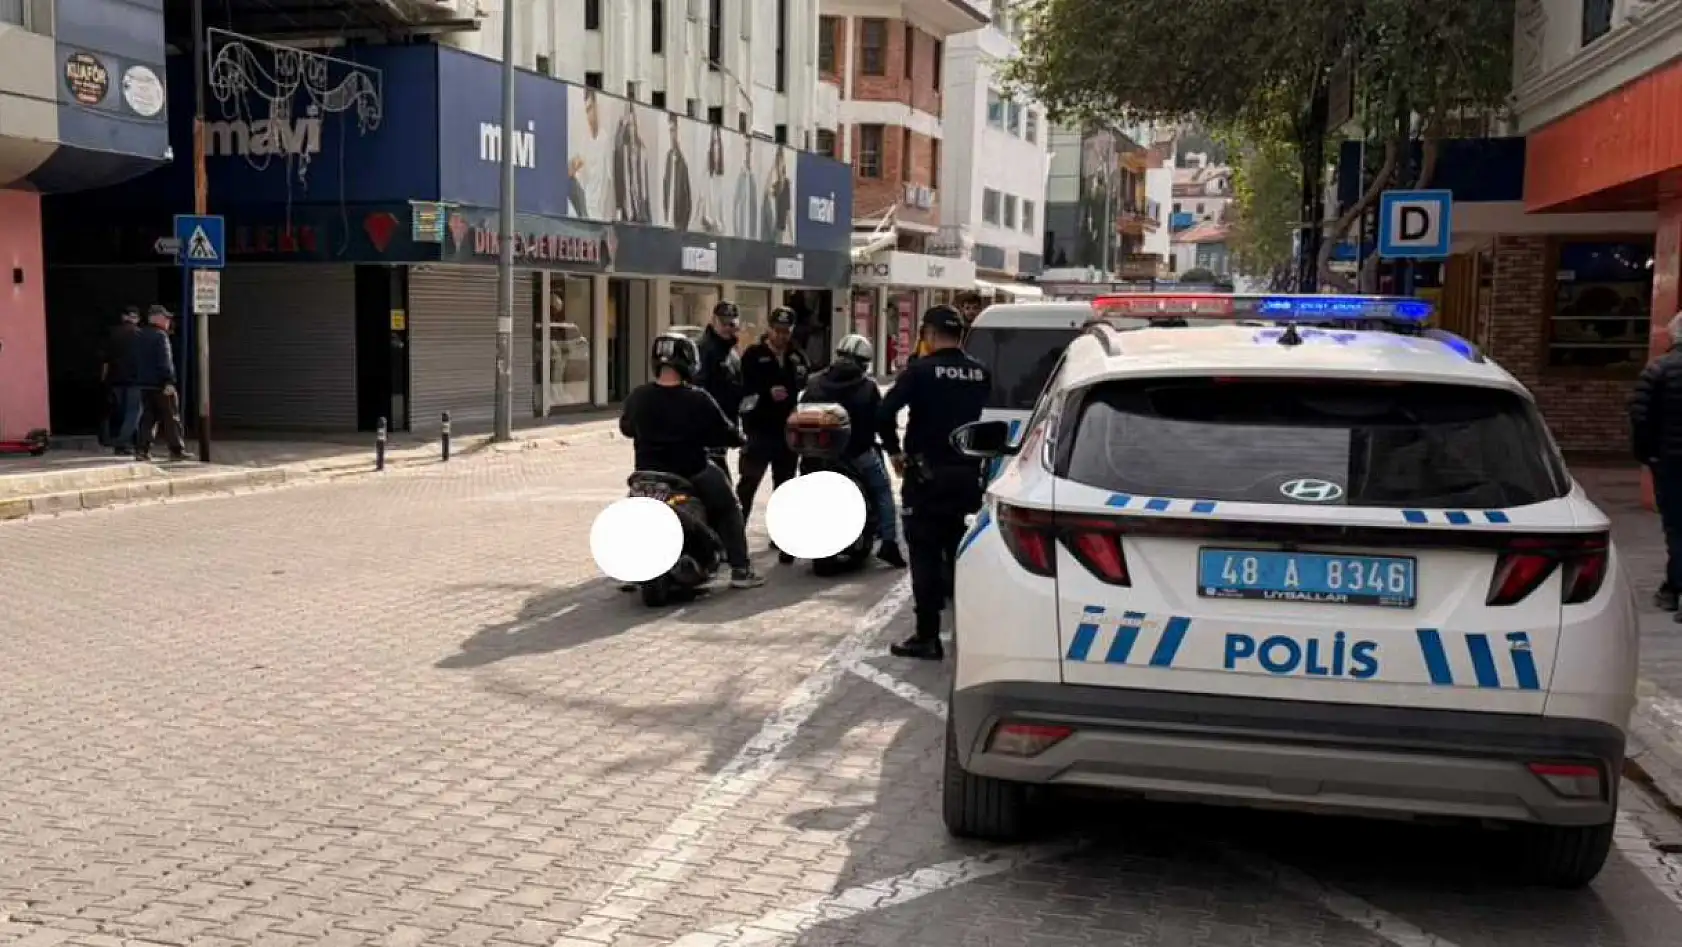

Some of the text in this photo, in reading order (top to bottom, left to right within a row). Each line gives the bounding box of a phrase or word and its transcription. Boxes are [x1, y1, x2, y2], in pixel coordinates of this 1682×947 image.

[204, 104, 320, 156] mavi
[480, 120, 536, 168] mvi
[808, 191, 834, 224] mavi
[1400, 206, 1429, 240] D
[1221, 557, 1405, 593] 48 A 8346
[1224, 630, 1378, 679] POLİS
